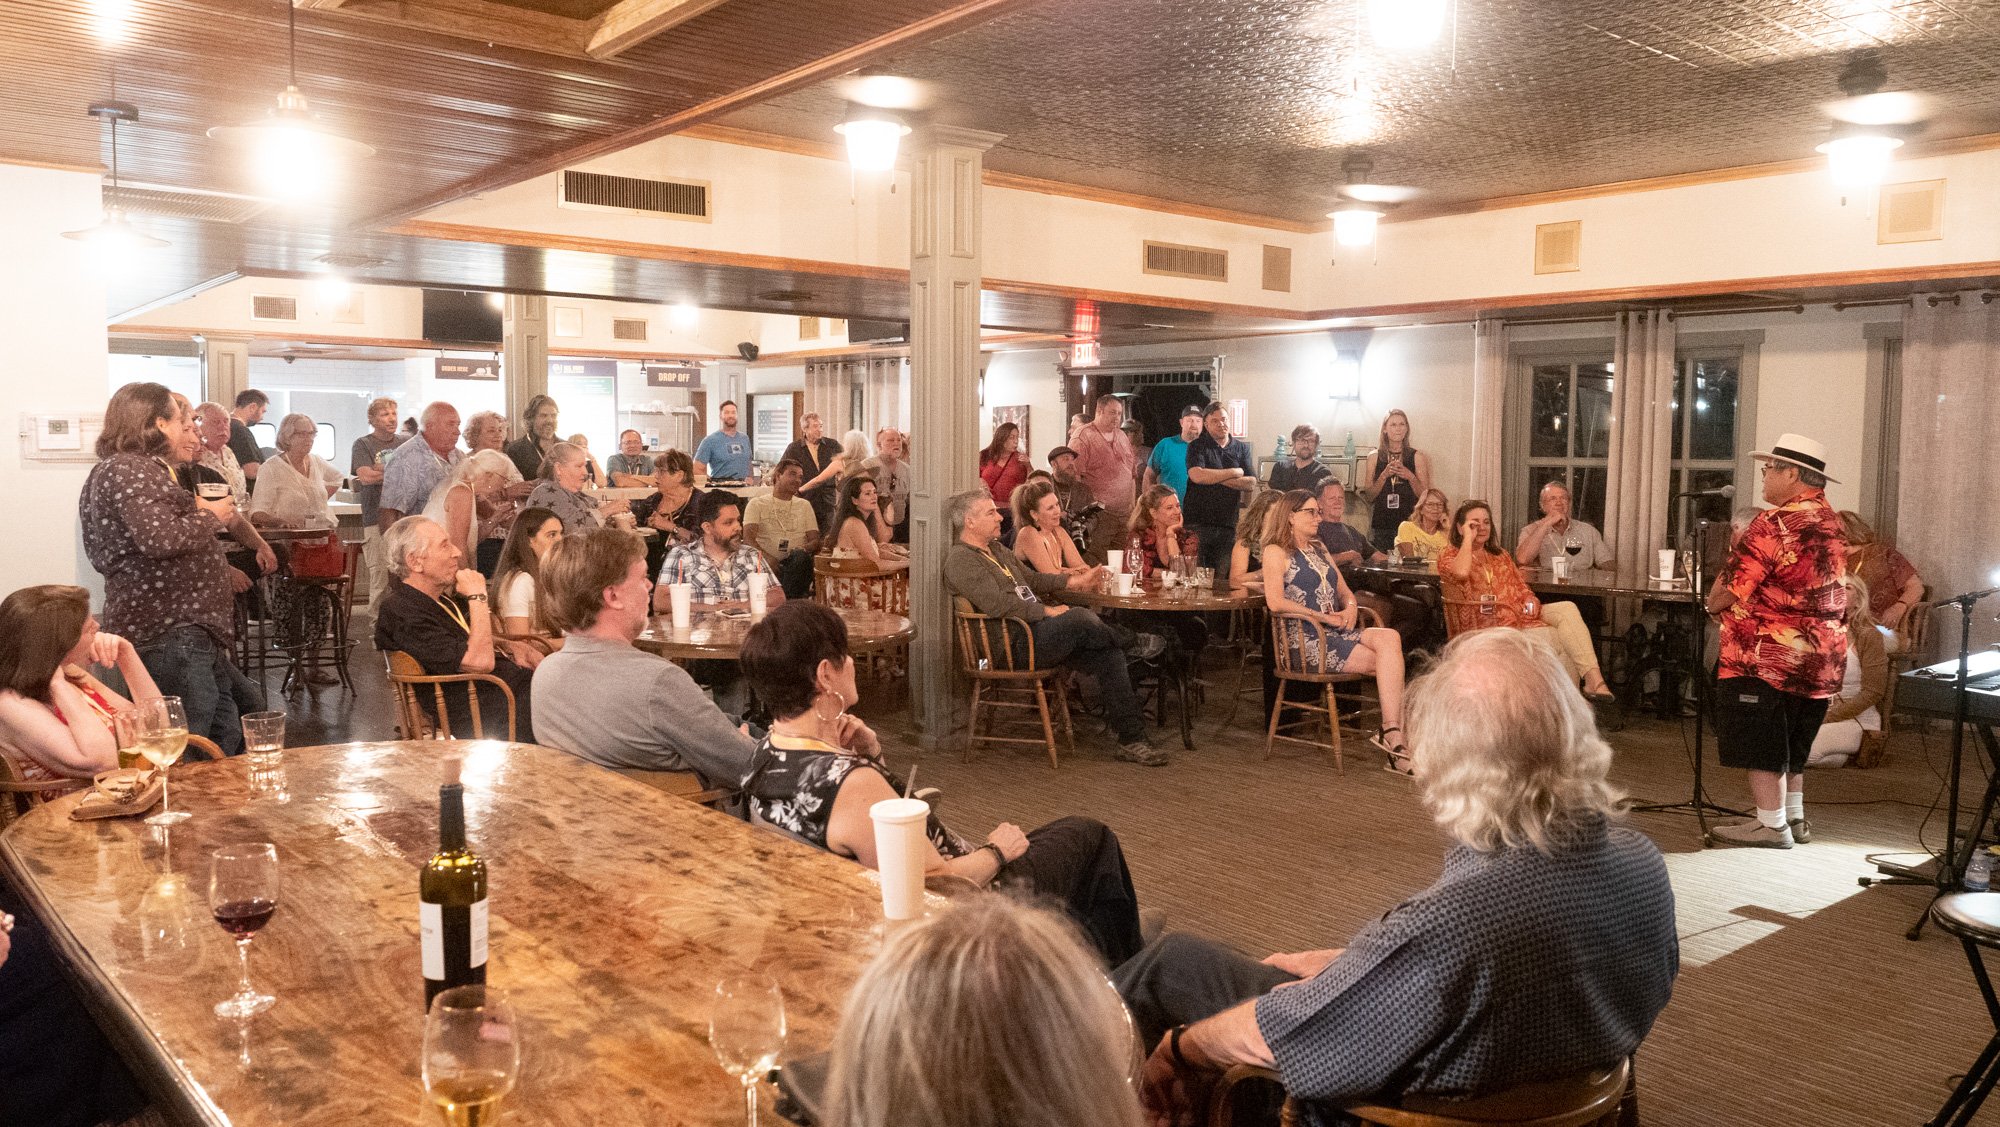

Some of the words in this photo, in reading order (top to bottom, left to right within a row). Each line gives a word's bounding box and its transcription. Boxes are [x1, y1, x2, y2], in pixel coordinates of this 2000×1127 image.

[1075, 343, 1094, 363] EXIT
[658, 372, 676, 382] DROP
[677, 373, 691, 383] OFF
